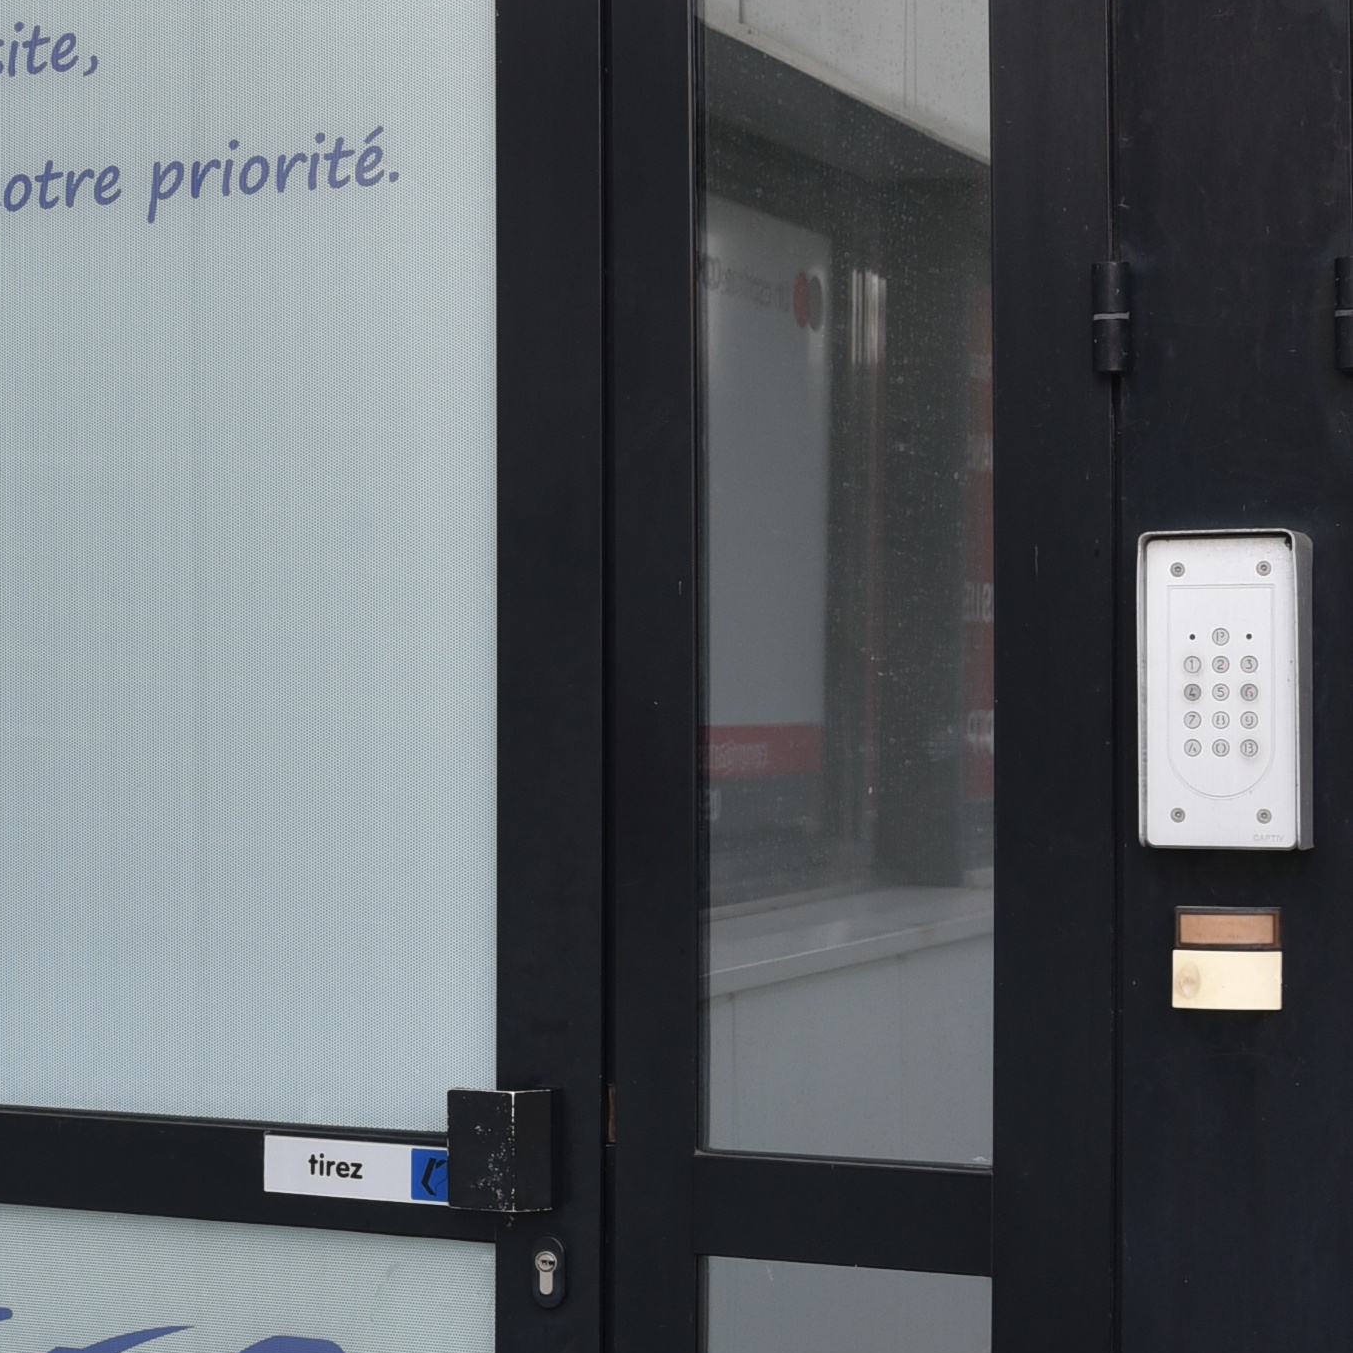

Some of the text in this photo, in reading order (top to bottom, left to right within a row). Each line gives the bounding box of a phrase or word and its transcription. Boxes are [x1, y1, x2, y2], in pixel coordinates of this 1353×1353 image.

[146, 126, 401, 225] priorité.
[1217, 659, 1225, 670] 2
[1246, 659, 1253, 670] 3
[1189, 687, 1254, 698] 4 5 6
[1189, 714, 1254, 726] 7 8 9
[308, 1152, 363, 1180] tirez
